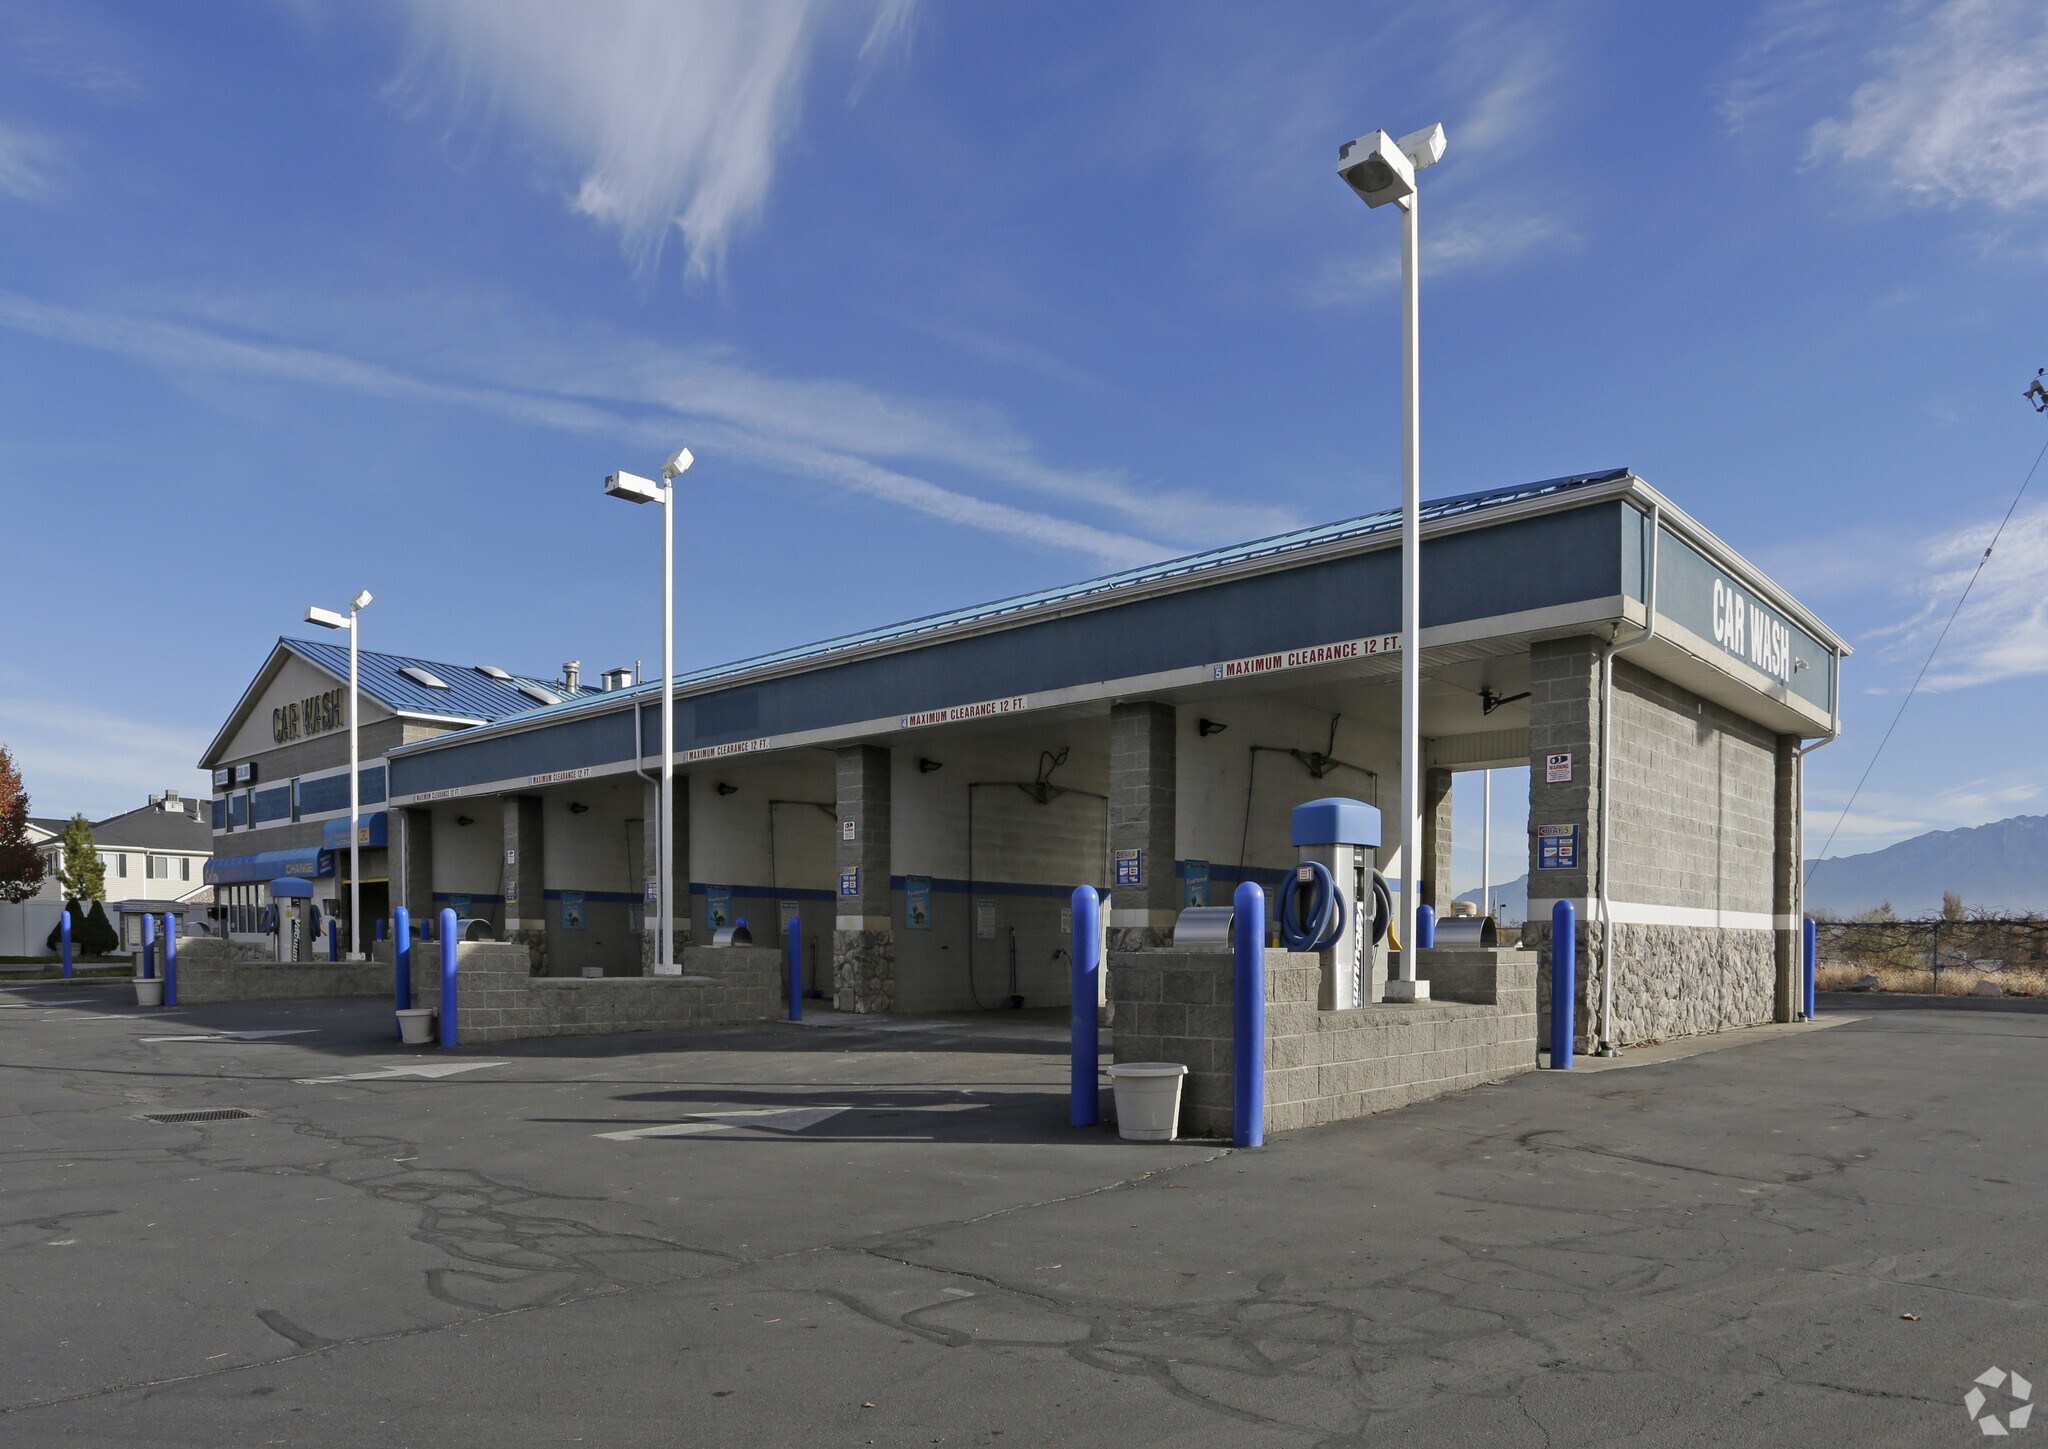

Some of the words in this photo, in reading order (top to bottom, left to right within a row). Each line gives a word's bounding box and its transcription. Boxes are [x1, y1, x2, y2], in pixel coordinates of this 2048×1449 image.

[1713, 578, 1745, 657] CAR
[1750, 603, 1790, 683] WASH
[1226, 655, 1282, 677] MAXIMUM
[1288, 642, 1357, 667] CLEARANCE
[1363, 639, 1377, 654] 12
[1383, 635, 1402, 651] FT.
[273, 703, 301, 743] CAR
[302, 688, 344, 735] WASH
[909, 710, 947, 726] MAXIMUM
[950, 702, 996, 720] CLEARANCE
[1000, 700, 1009, 712] 12
[1013, 698, 1025, 710] FT.
[689, 747, 715, 760] MAXIMUM
[717, 742, 748, 756] CLEARANCE
[751, 740, 757, 750] 12
[759, 739, 769, 749] FT.
[553, 770, 576, 781] CLEARANCE
[285, 863, 313, 874] CHANGE
